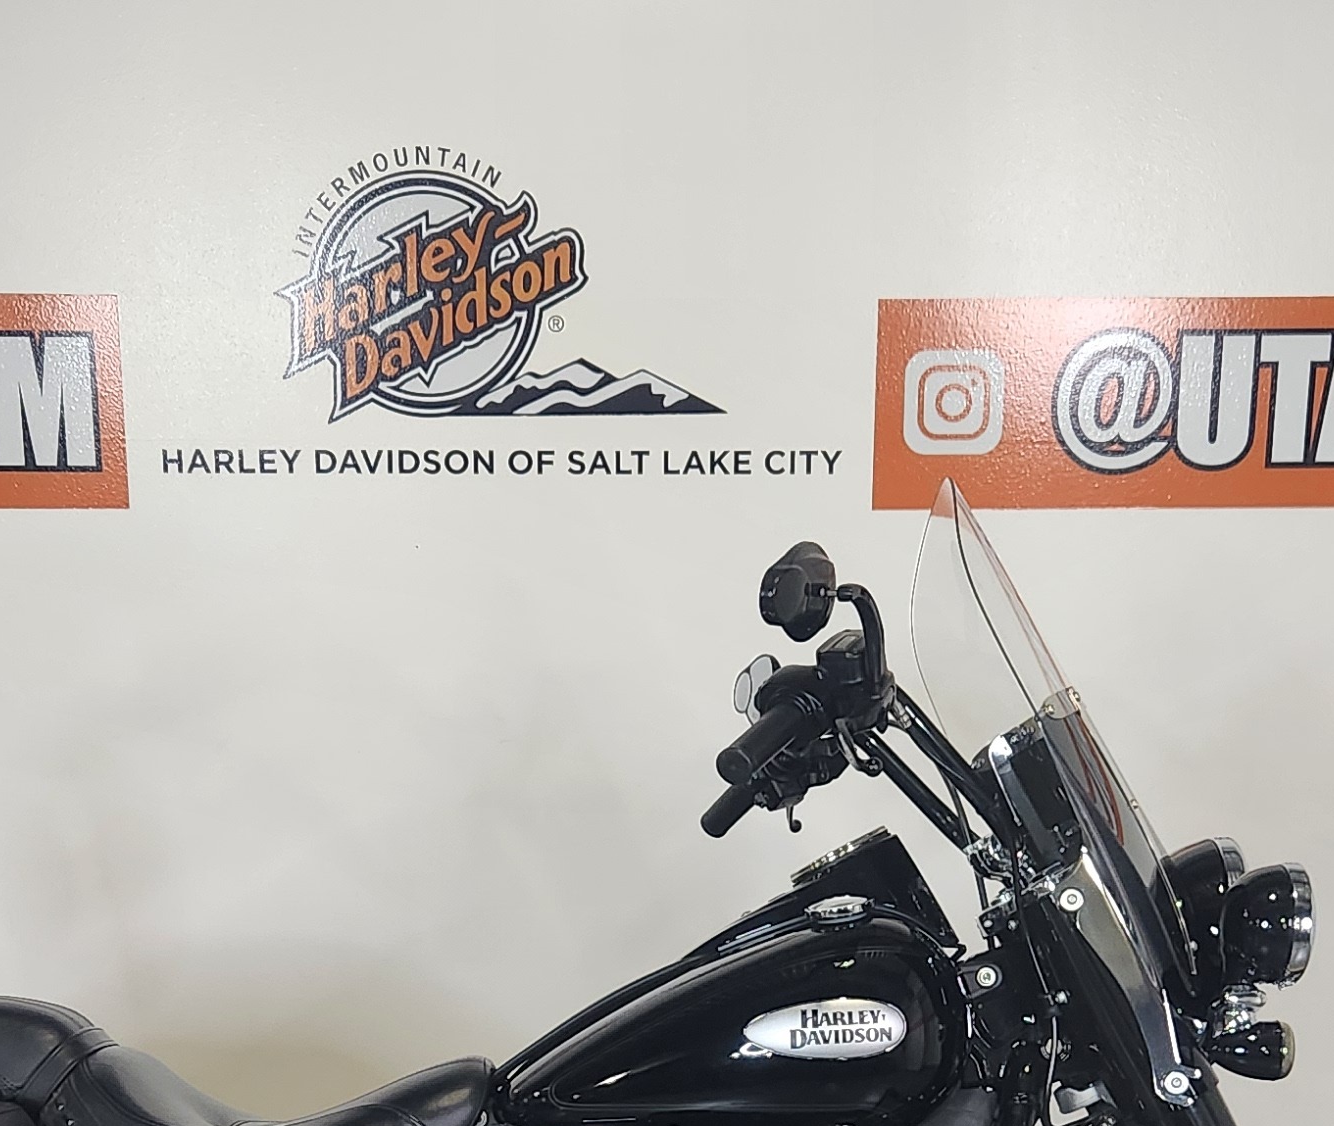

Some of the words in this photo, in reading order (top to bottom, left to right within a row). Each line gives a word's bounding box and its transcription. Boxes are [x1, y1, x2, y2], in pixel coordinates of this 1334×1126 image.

[292, 145, 502, 258] INTERMOUNTAIN
[343, 241, 572, 399] Davidson
[162, 448, 300, 475] HARLEY
[314, 449, 493, 475] DAVIDSON
[508, 450, 555, 475] OF
[567, 450, 650, 475] SALT
[663, 450, 752, 475] LAKE
[764, 450, 842, 475] CITY
[789, 1026, 893, 1050] DAVIDSON
